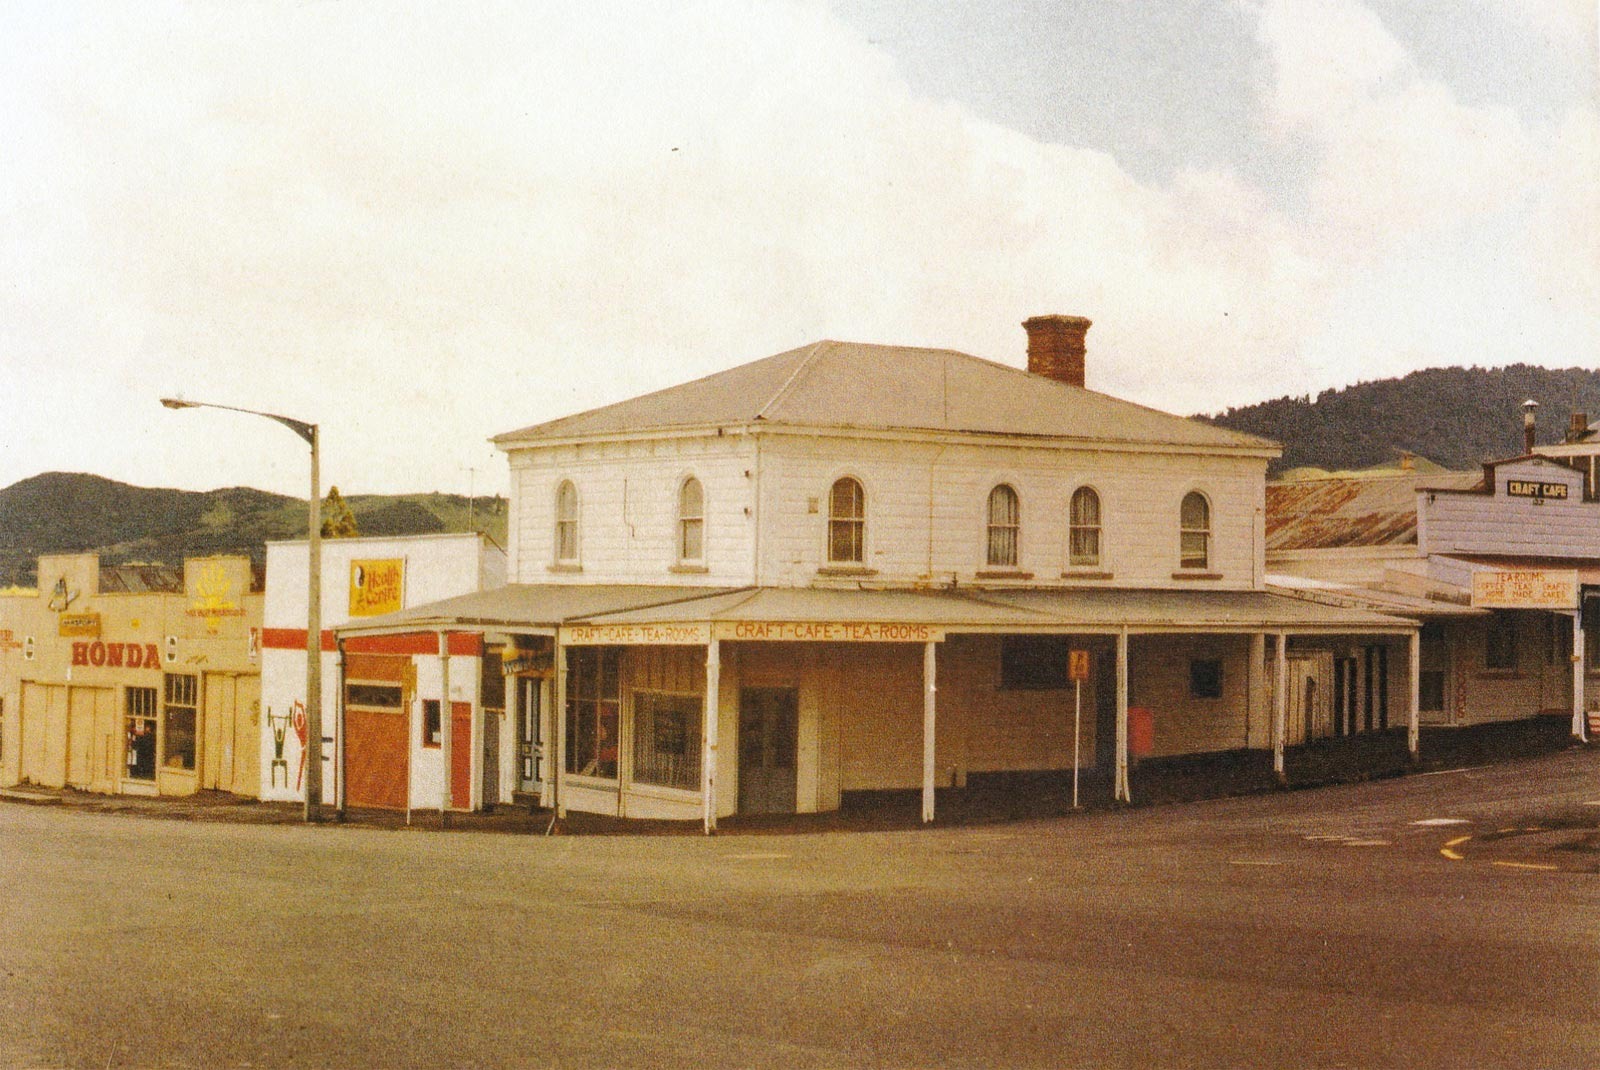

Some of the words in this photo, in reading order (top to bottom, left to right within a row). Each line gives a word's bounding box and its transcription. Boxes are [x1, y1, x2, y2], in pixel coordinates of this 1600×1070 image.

[1509, 482, 1540, 496] CRAFT
[1542, 483, 1568, 497] CAFE
[368, 566, 399, 592] Health
[71, 641, 162, 670] HONDA
